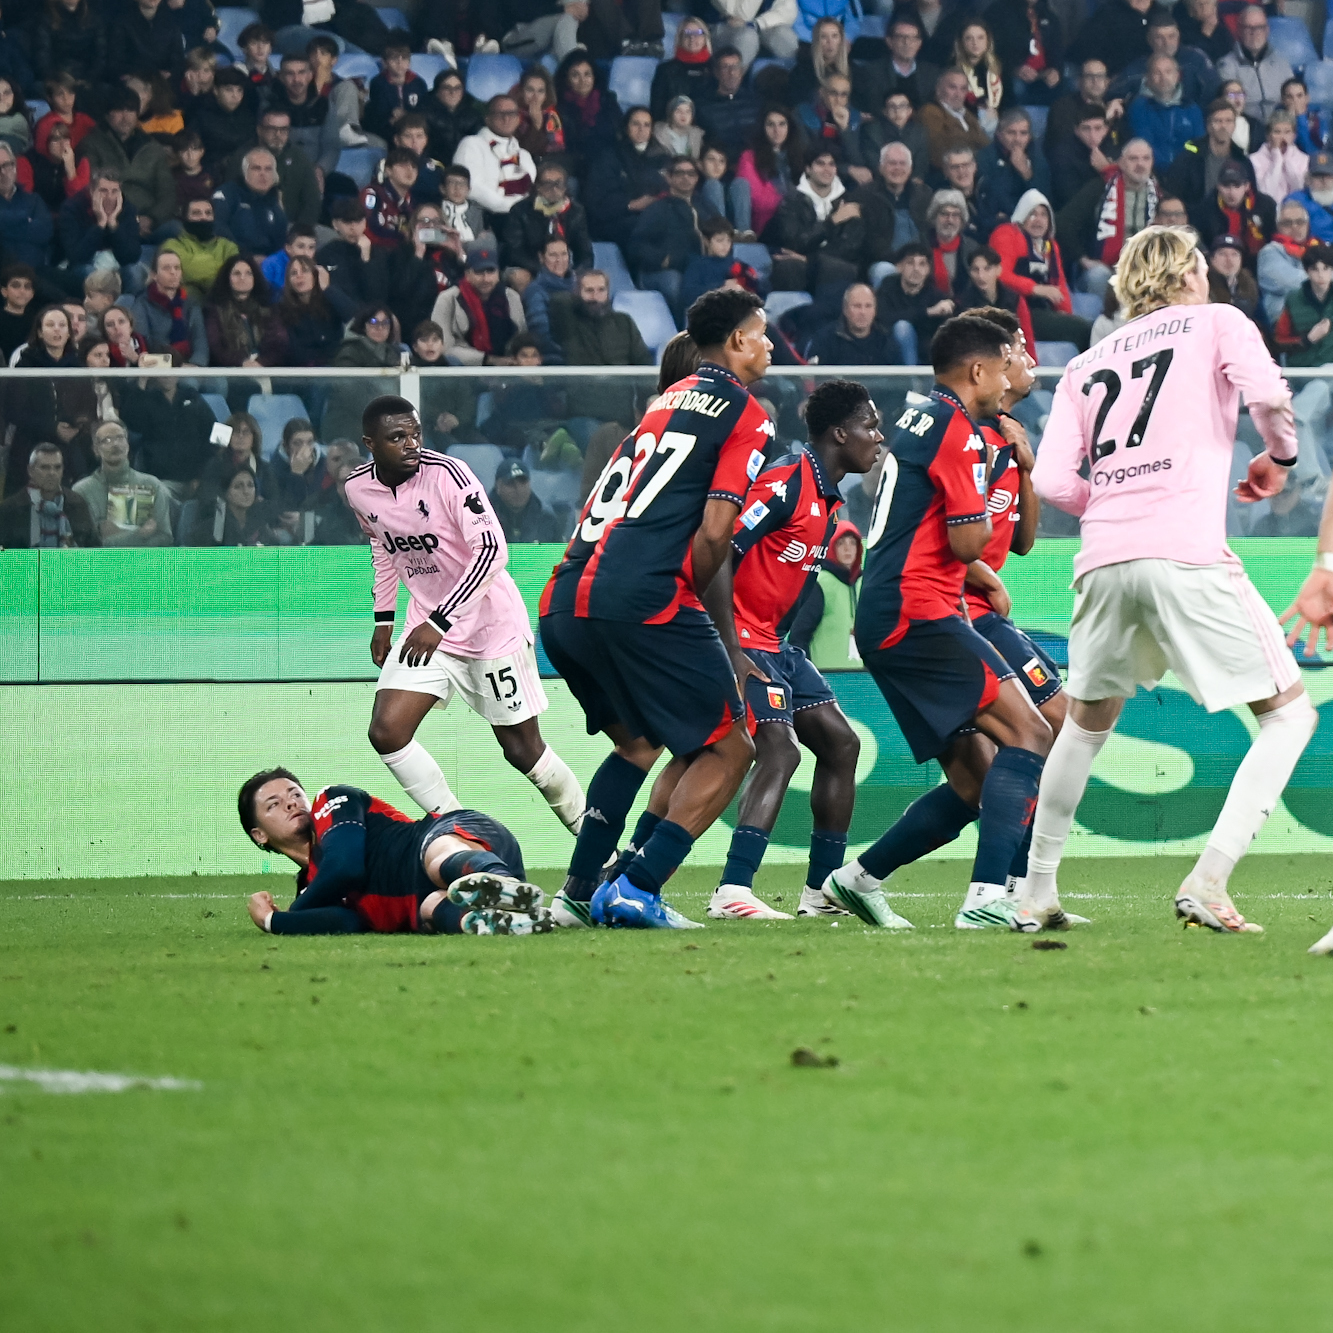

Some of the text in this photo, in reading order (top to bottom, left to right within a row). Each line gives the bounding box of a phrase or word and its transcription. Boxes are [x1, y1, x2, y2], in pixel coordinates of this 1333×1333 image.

[1081, 348, 1174, 465] 27
[1094, 458, 1172, 486] Cygames
[382, 531, 439, 555] Jeep
[484, 666, 518, 703] 15
